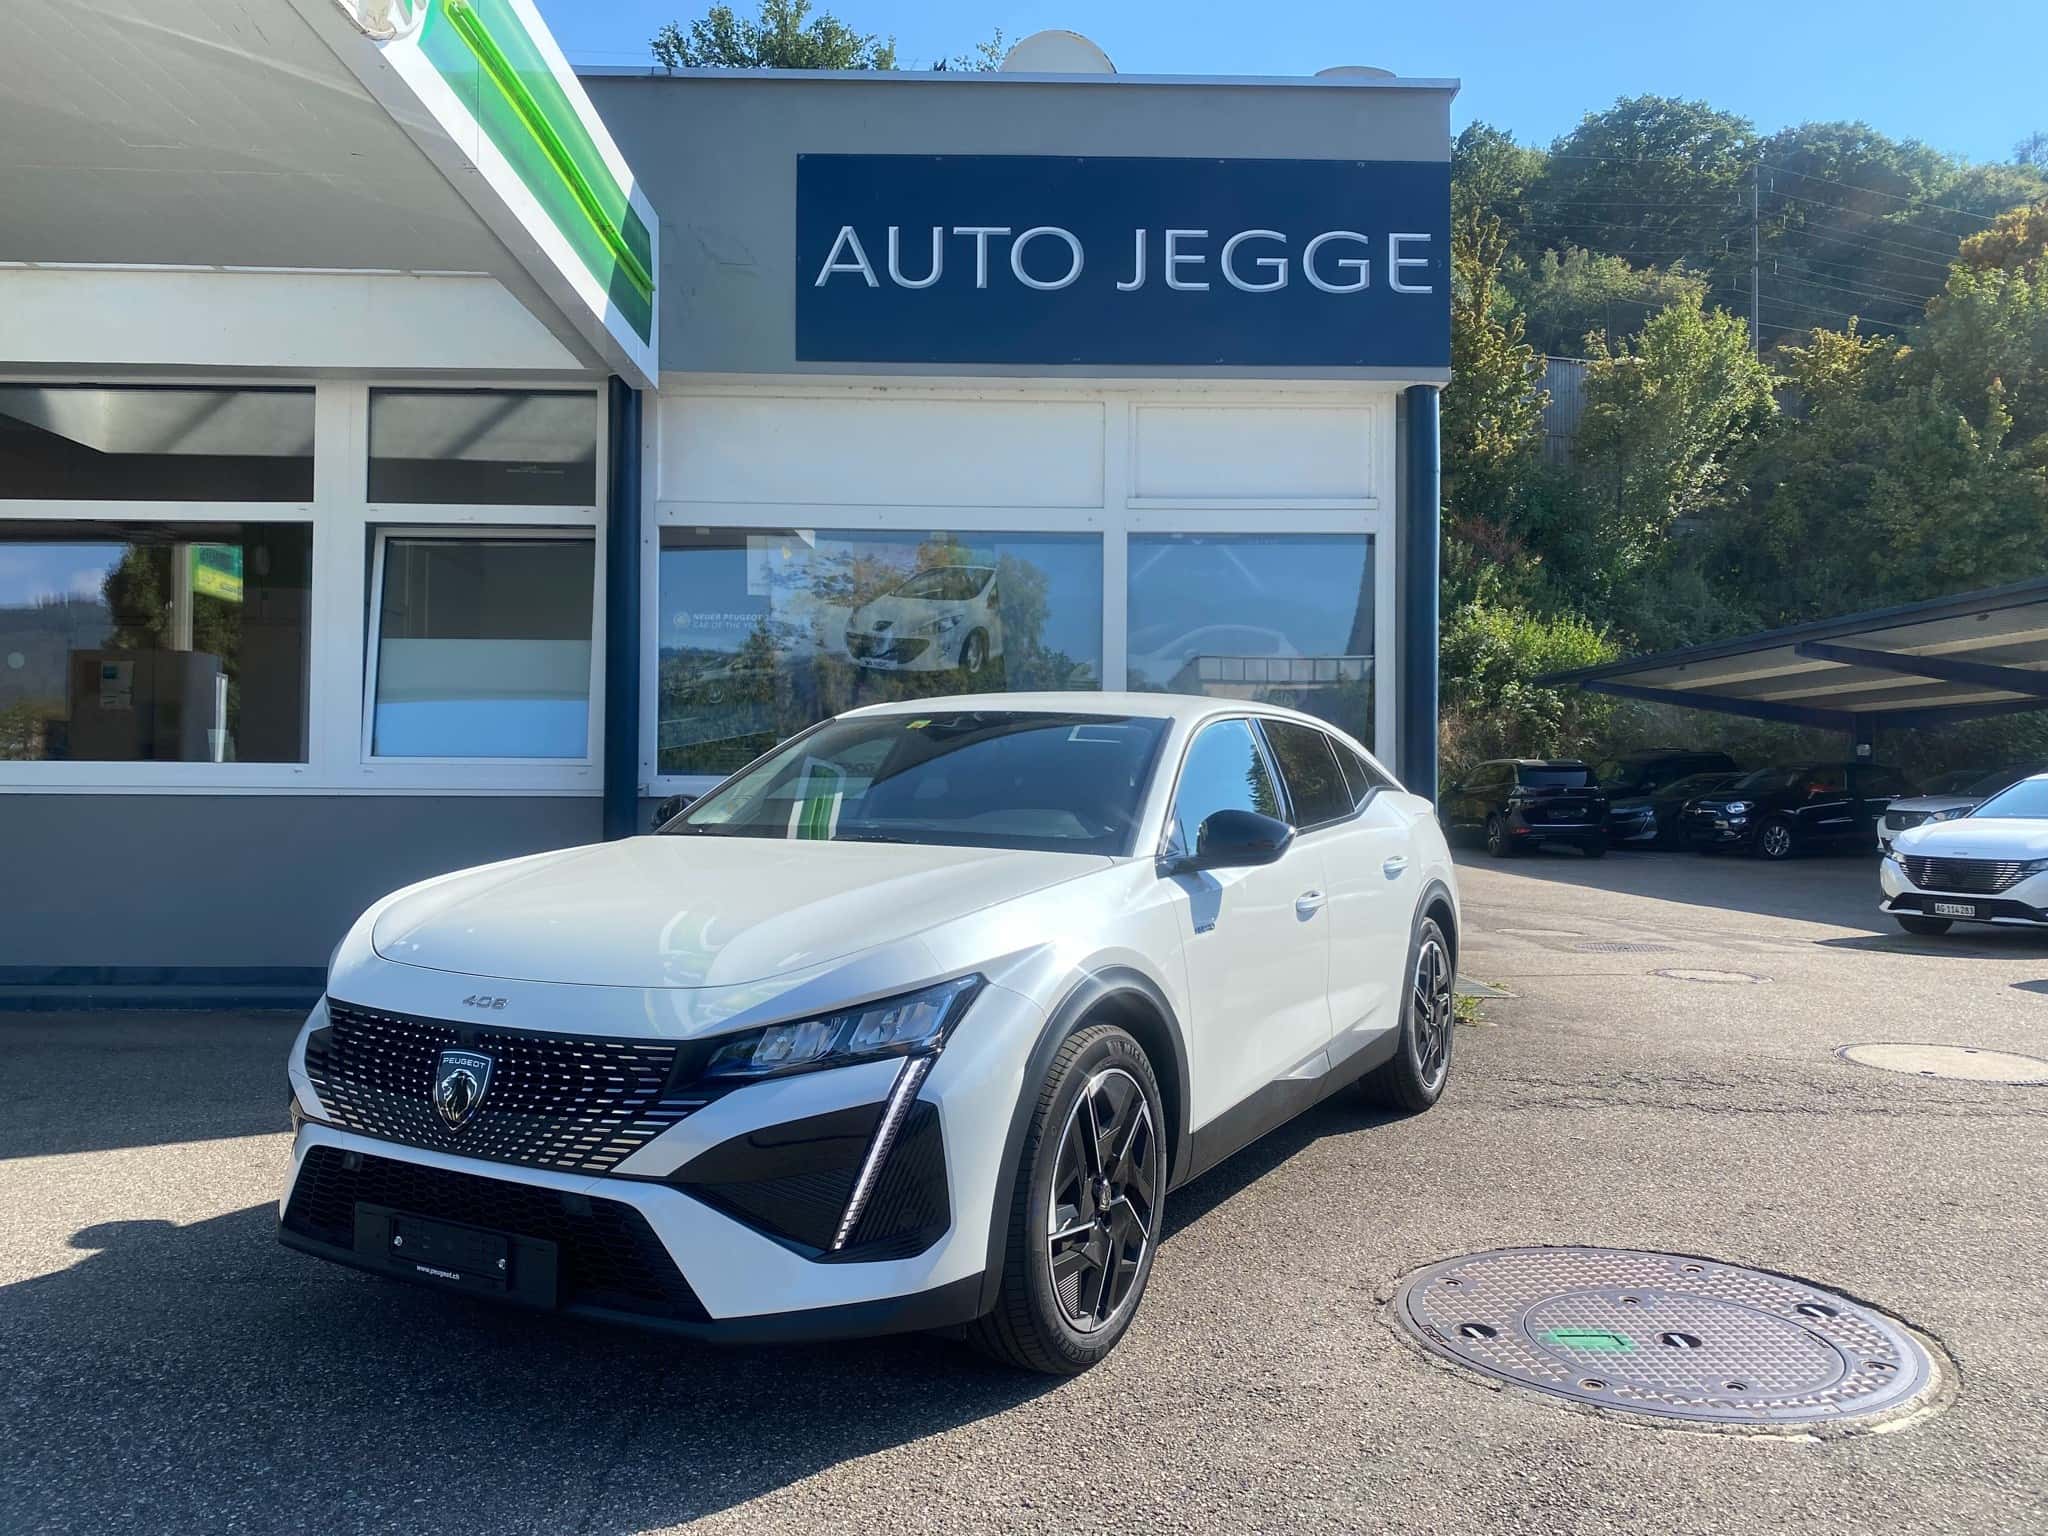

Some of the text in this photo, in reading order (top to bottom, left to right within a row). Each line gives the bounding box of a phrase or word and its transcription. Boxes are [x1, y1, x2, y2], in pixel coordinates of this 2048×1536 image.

[814, 225, 1433, 294] AUTO JEGGE
[723, 613, 763, 622] PEUGEOT
[463, 994, 508, 1010] 408
[443, 1057, 486, 1069] PEUGEOT
[416, 1264, 460, 1280] www.peugeot.ch
